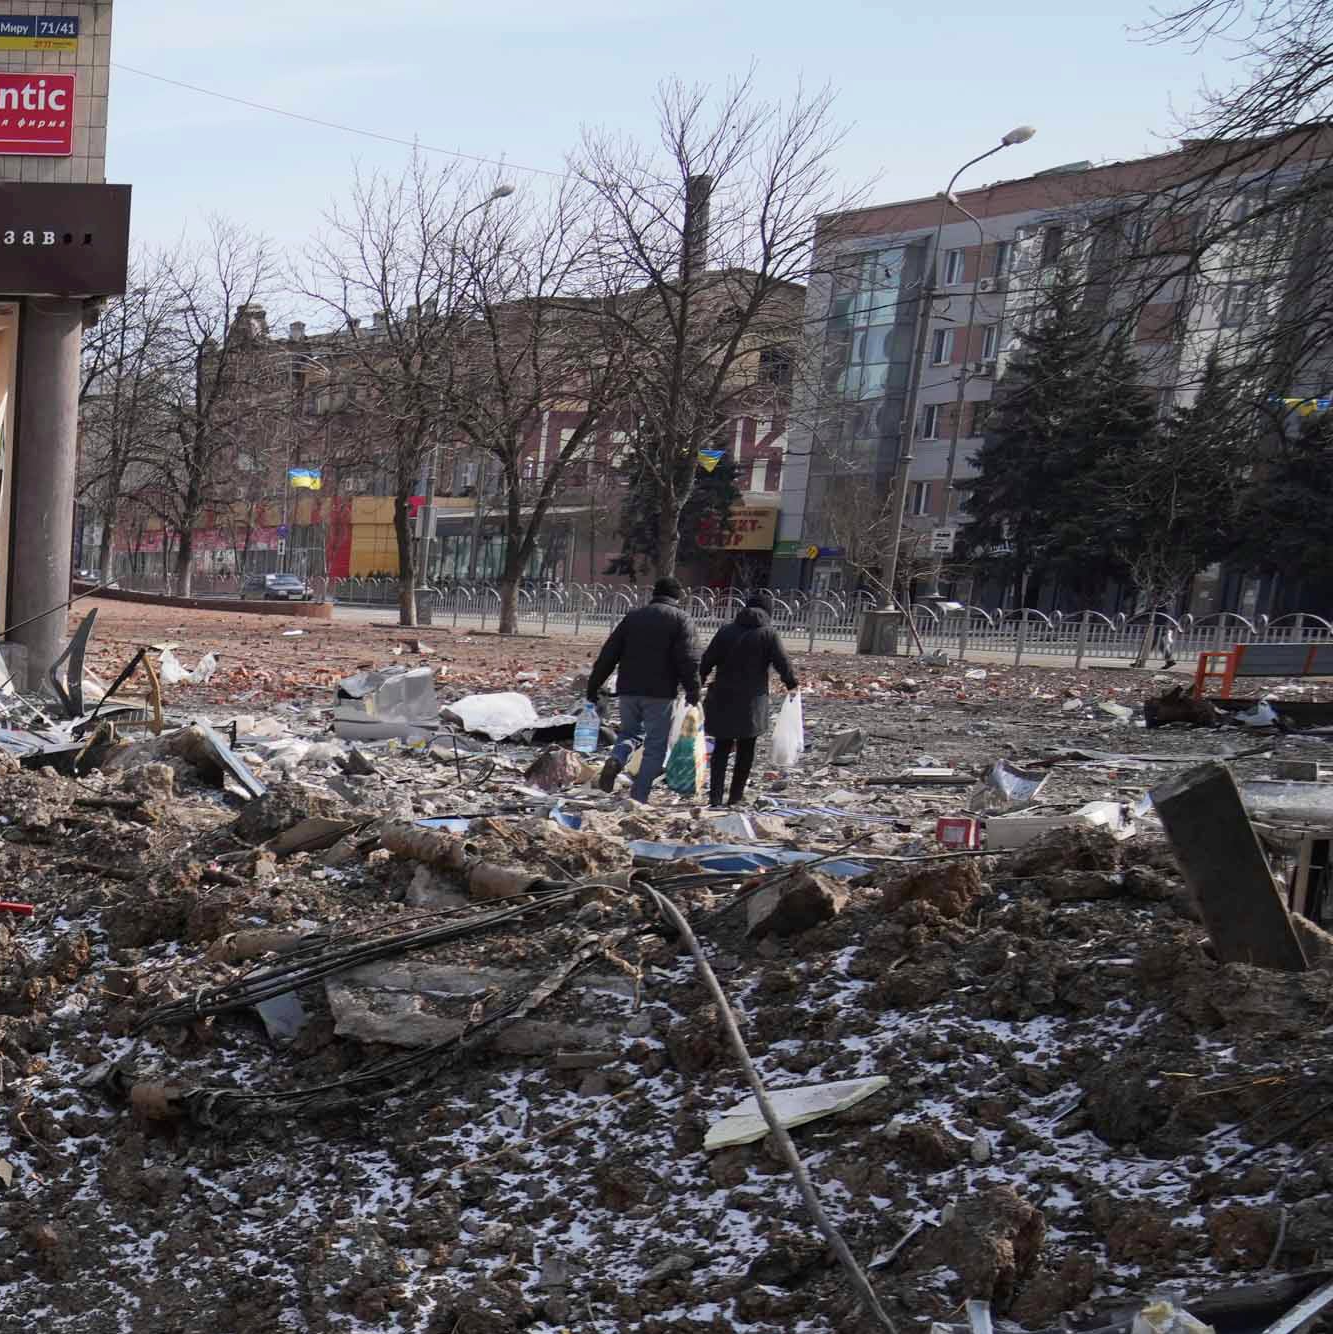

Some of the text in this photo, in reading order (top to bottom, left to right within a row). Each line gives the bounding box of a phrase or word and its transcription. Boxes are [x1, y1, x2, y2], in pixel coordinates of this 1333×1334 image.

[0, 23, 29, 35] Миру
[40, 21, 75, 34] 71/41
[17, 116, 66, 128] фирма
